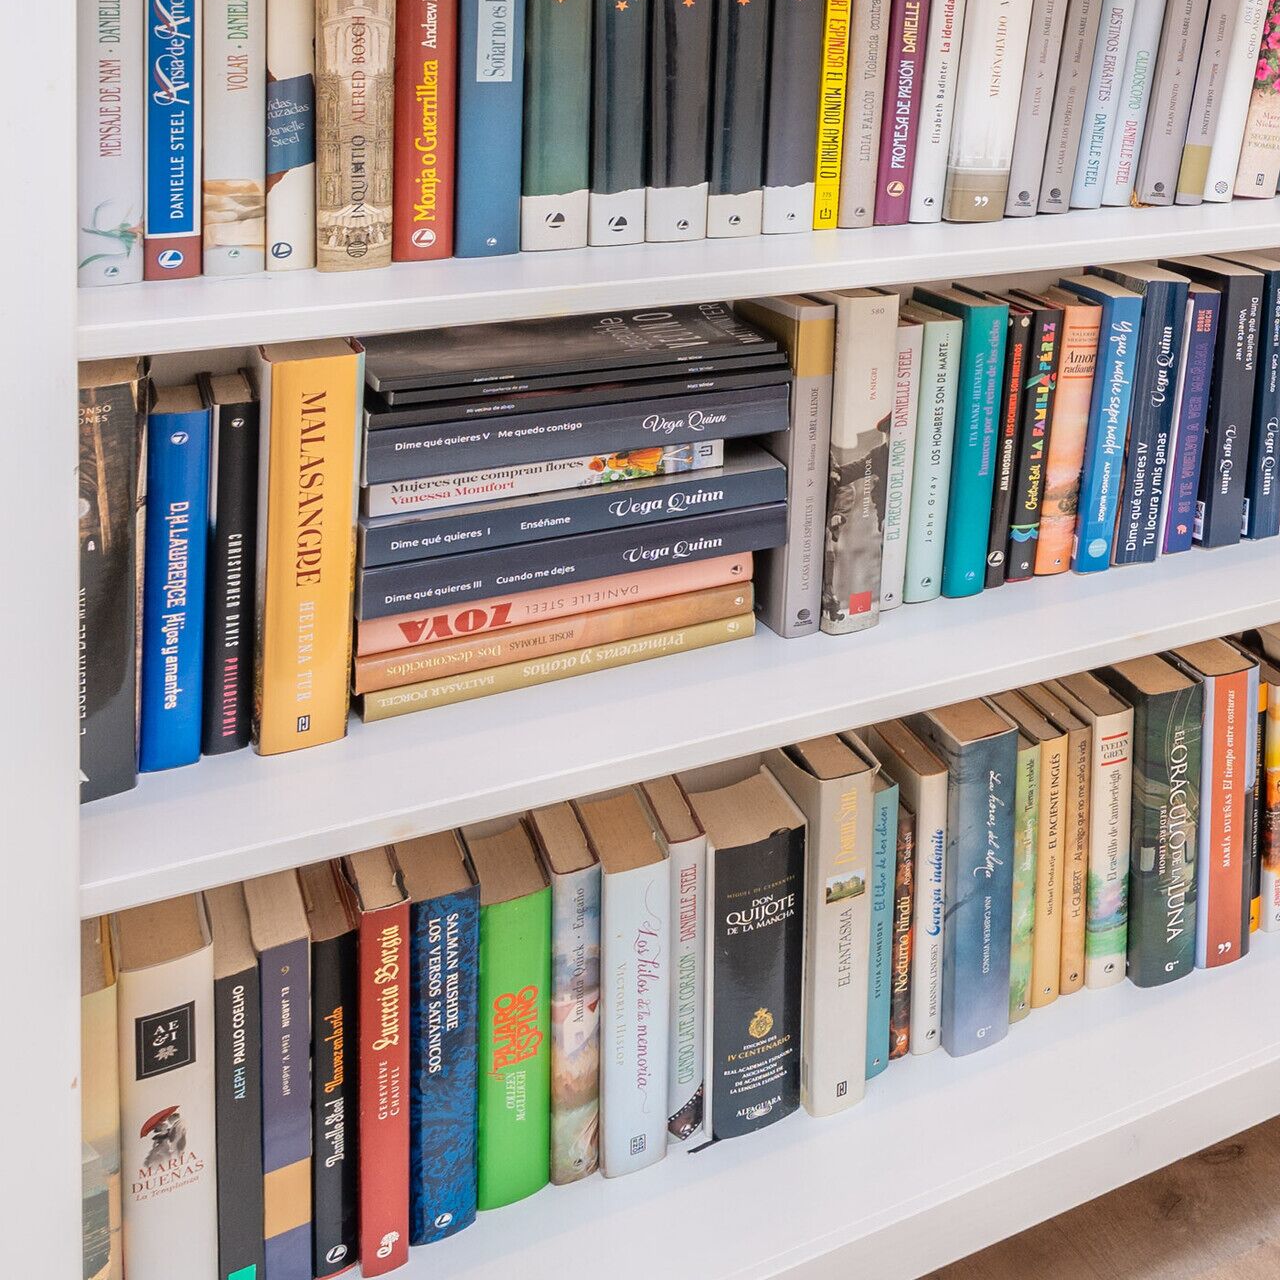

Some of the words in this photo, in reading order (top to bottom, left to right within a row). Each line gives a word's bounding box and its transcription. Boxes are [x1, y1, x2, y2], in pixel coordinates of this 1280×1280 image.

[352, 15, 367, 65] BOSCH
[421, 3, 437, 49] Andrew
[902, 2, 920, 53] DANIELLE
[171, 38, 186, 54] de
[226, 54, 248, 92] VOLAR
[898, 60, 914, 98] PASIÓN
[352, 71, 367, 123] ALFRED
[413, 59, 438, 150] Guerrillera
[897, 99, 910, 114] DE
[170, 110, 185, 150] STEEL
[891, 116, 909, 168] PROMESA
[421, 152, 436, 164] o
[170, 155, 185, 220] DANIELLE
[413, 166, 440, 222] Monja
[395, 440, 421, 451] Dime
[423, 437, 443, 449] qué
[444, 434, 480, 446] quieres
[482, 432, 490, 440] V
[497, 430, 512, 439] Me
[514, 426, 545, 438] quedo
[546, 421, 582, 435] contigo
[643, 414, 684, 433] Vega
[687, 410, 727, 431] Quinn
[296, 391, 327, 587] MALASANGRE
[521, 515, 571, 530] Enséñame
[226, 533, 242, 608] CHRISTOPHER
[526, 598, 565, 615] STEEL
[572, 584, 639, 608] DANIELLE
[225, 613, 239, 648] DAVIS
[398, 602, 513, 644] ZOYA
[1223, 779, 1233, 790] El
[1049, 789, 1059, 837] PACIENTE
[1049, 836, 1057, 849] EL
[1223, 836, 1233, 867] MARÍA
[726, 894, 795, 926] QUIJOTE
[752, 895, 774, 908] DON
[1167, 884, 1184, 943] LUNA
[429, 918, 442, 943] LOS
[446, 913, 458, 969] SALMAN
[727, 927, 739, 936] DE
[742, 923, 753, 933] LA
[756, 909, 795, 930] MANCHA
[429, 947, 442, 997] VERSOS
[233, 985, 244, 1027] COELHO
[447, 972, 458, 1031] RUSHDIE
[234, 1028, 245, 1064] PAULO
[235, 1066, 246, 1100] ALEPH
[736, 1095, 782, 1118] ALFAGUARA
